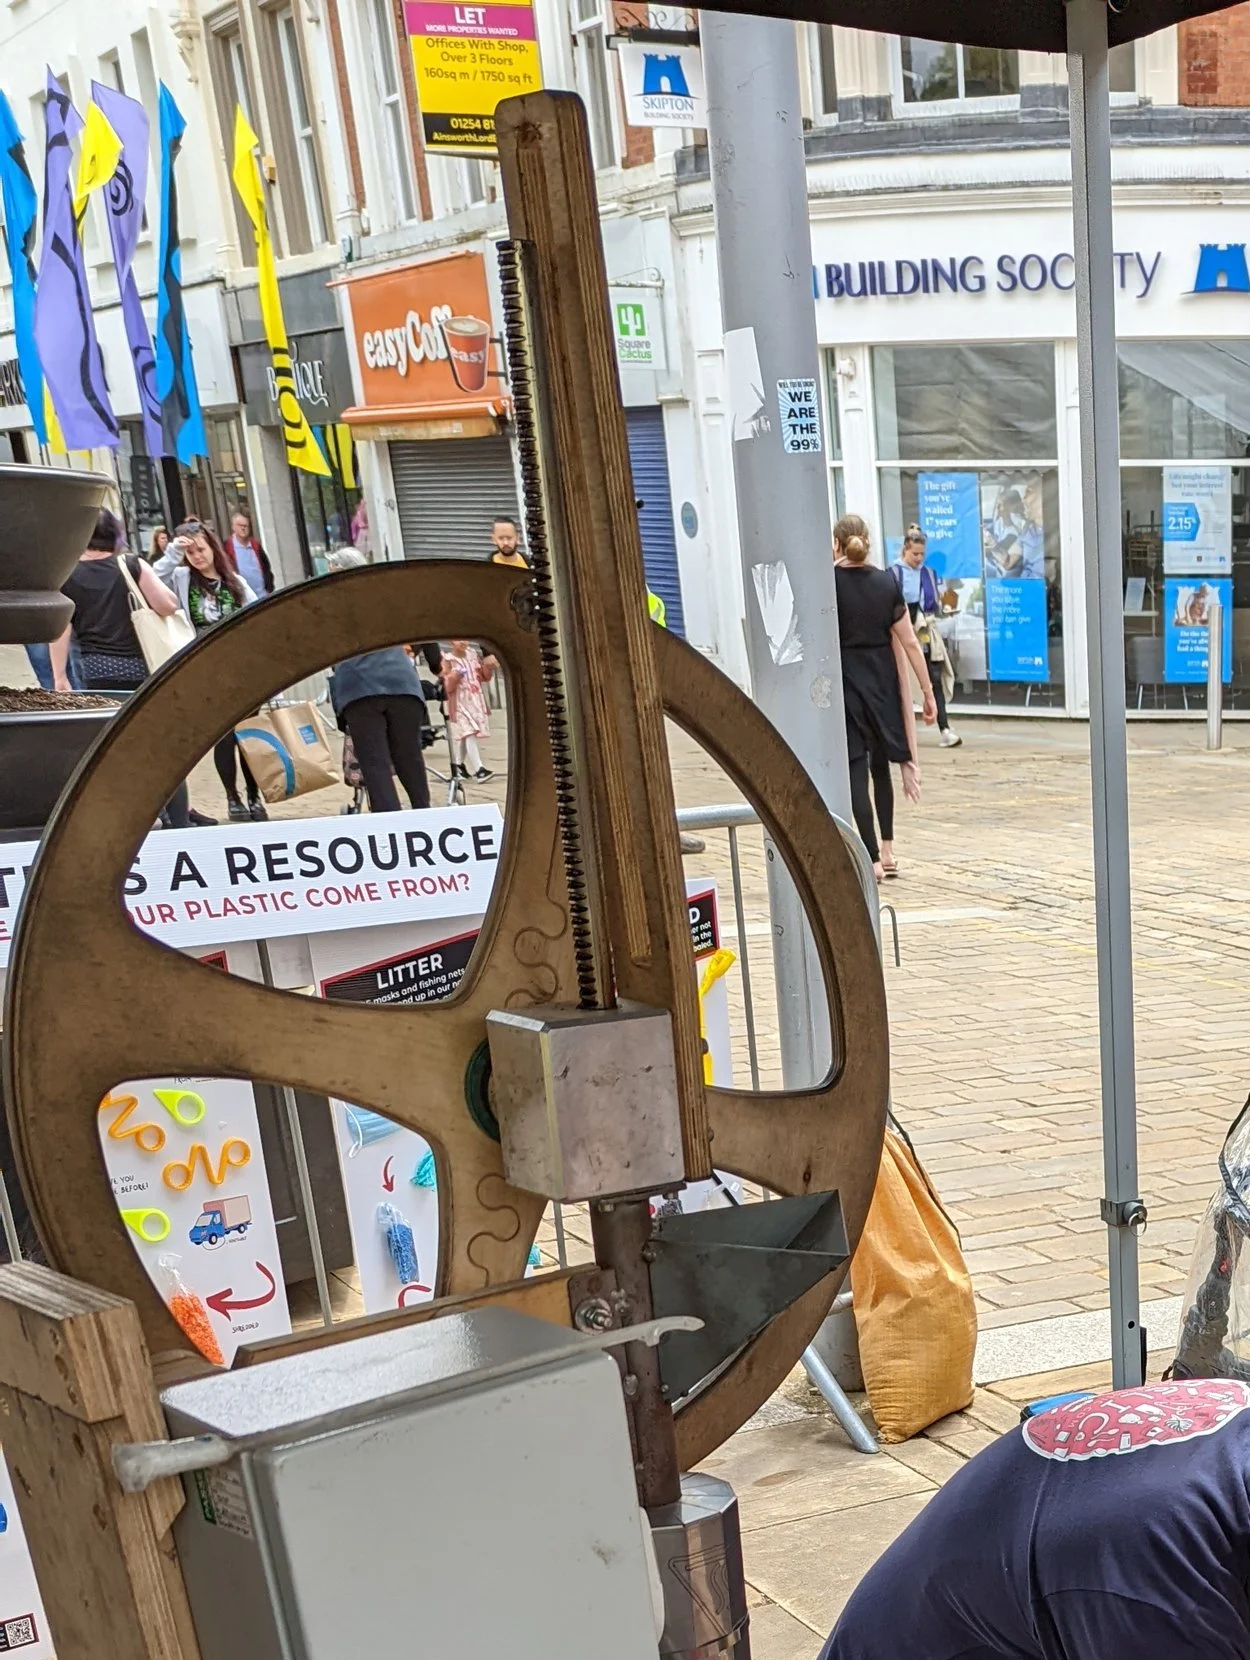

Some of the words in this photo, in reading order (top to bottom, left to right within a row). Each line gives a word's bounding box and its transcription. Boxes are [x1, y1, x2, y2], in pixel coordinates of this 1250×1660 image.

[454, 6, 486, 25] LET
[425, 24, 447, 33] MORE
[448, 25, 487, 35] PROPERTIES
[488, 27, 518, 36] WANTED
[426, 37, 466, 49] Offices
[468, 39, 495, 51] With
[497, 40, 529, 54] Shop,
[440, 51, 467, 63] Over
[470, 53, 477, 64] 3
[480, 53, 514, 66] Floors
[424, 67, 457, 82] 160sq
[459, 70, 470, 80] m
[481, 70, 506, 83] 1750
[508, 73, 521, 86] sq
[523, 72, 534, 85] ft
[643, 97, 694, 112] SKIPTON
[644, 111, 671, 120] BUILDING
[672, 112, 694, 121] SOCIETY
[450, 118, 481, 130] 01254
[825, 255, 986, 299] BUILDING
[996, 250, 1163, 299] SOCTY
[617, 338, 651, 351] Square
[618, 348, 652, 360] Cactus
[788, 391, 813, 403] WE
[787, 407, 816, 419] ARE
[788, 423, 817, 435] THE
[790, 439, 819, 451] 99%
[924, 481, 939, 491] The
[940, 482, 956, 493] gift
[924, 494, 950, 505] you've
[925, 504, 953, 514] waited
[935, 517, 957, 528] years
[938, 530, 953, 541] give
[169, 852, 209, 892] A
[224, 824, 499, 885] RESOURCE
[184, 891, 299, 926] PLASTIC
[304, 880, 382, 909] COME
[388, 872, 471, 899] FROM?
[700, 930, 712, 939] the
[376, 953, 444, 990] LITTER
[373, 990, 400, 1004] masks
[401, 984, 418, 995] and
[419, 973, 447, 990] fishing
[448, 967, 465, 979] nets
[415, 992, 426, 1004] up
[428, 988, 436, 997] in
[437, 984, 451, 994] our
[120, 1174, 134, 1185] YOU
